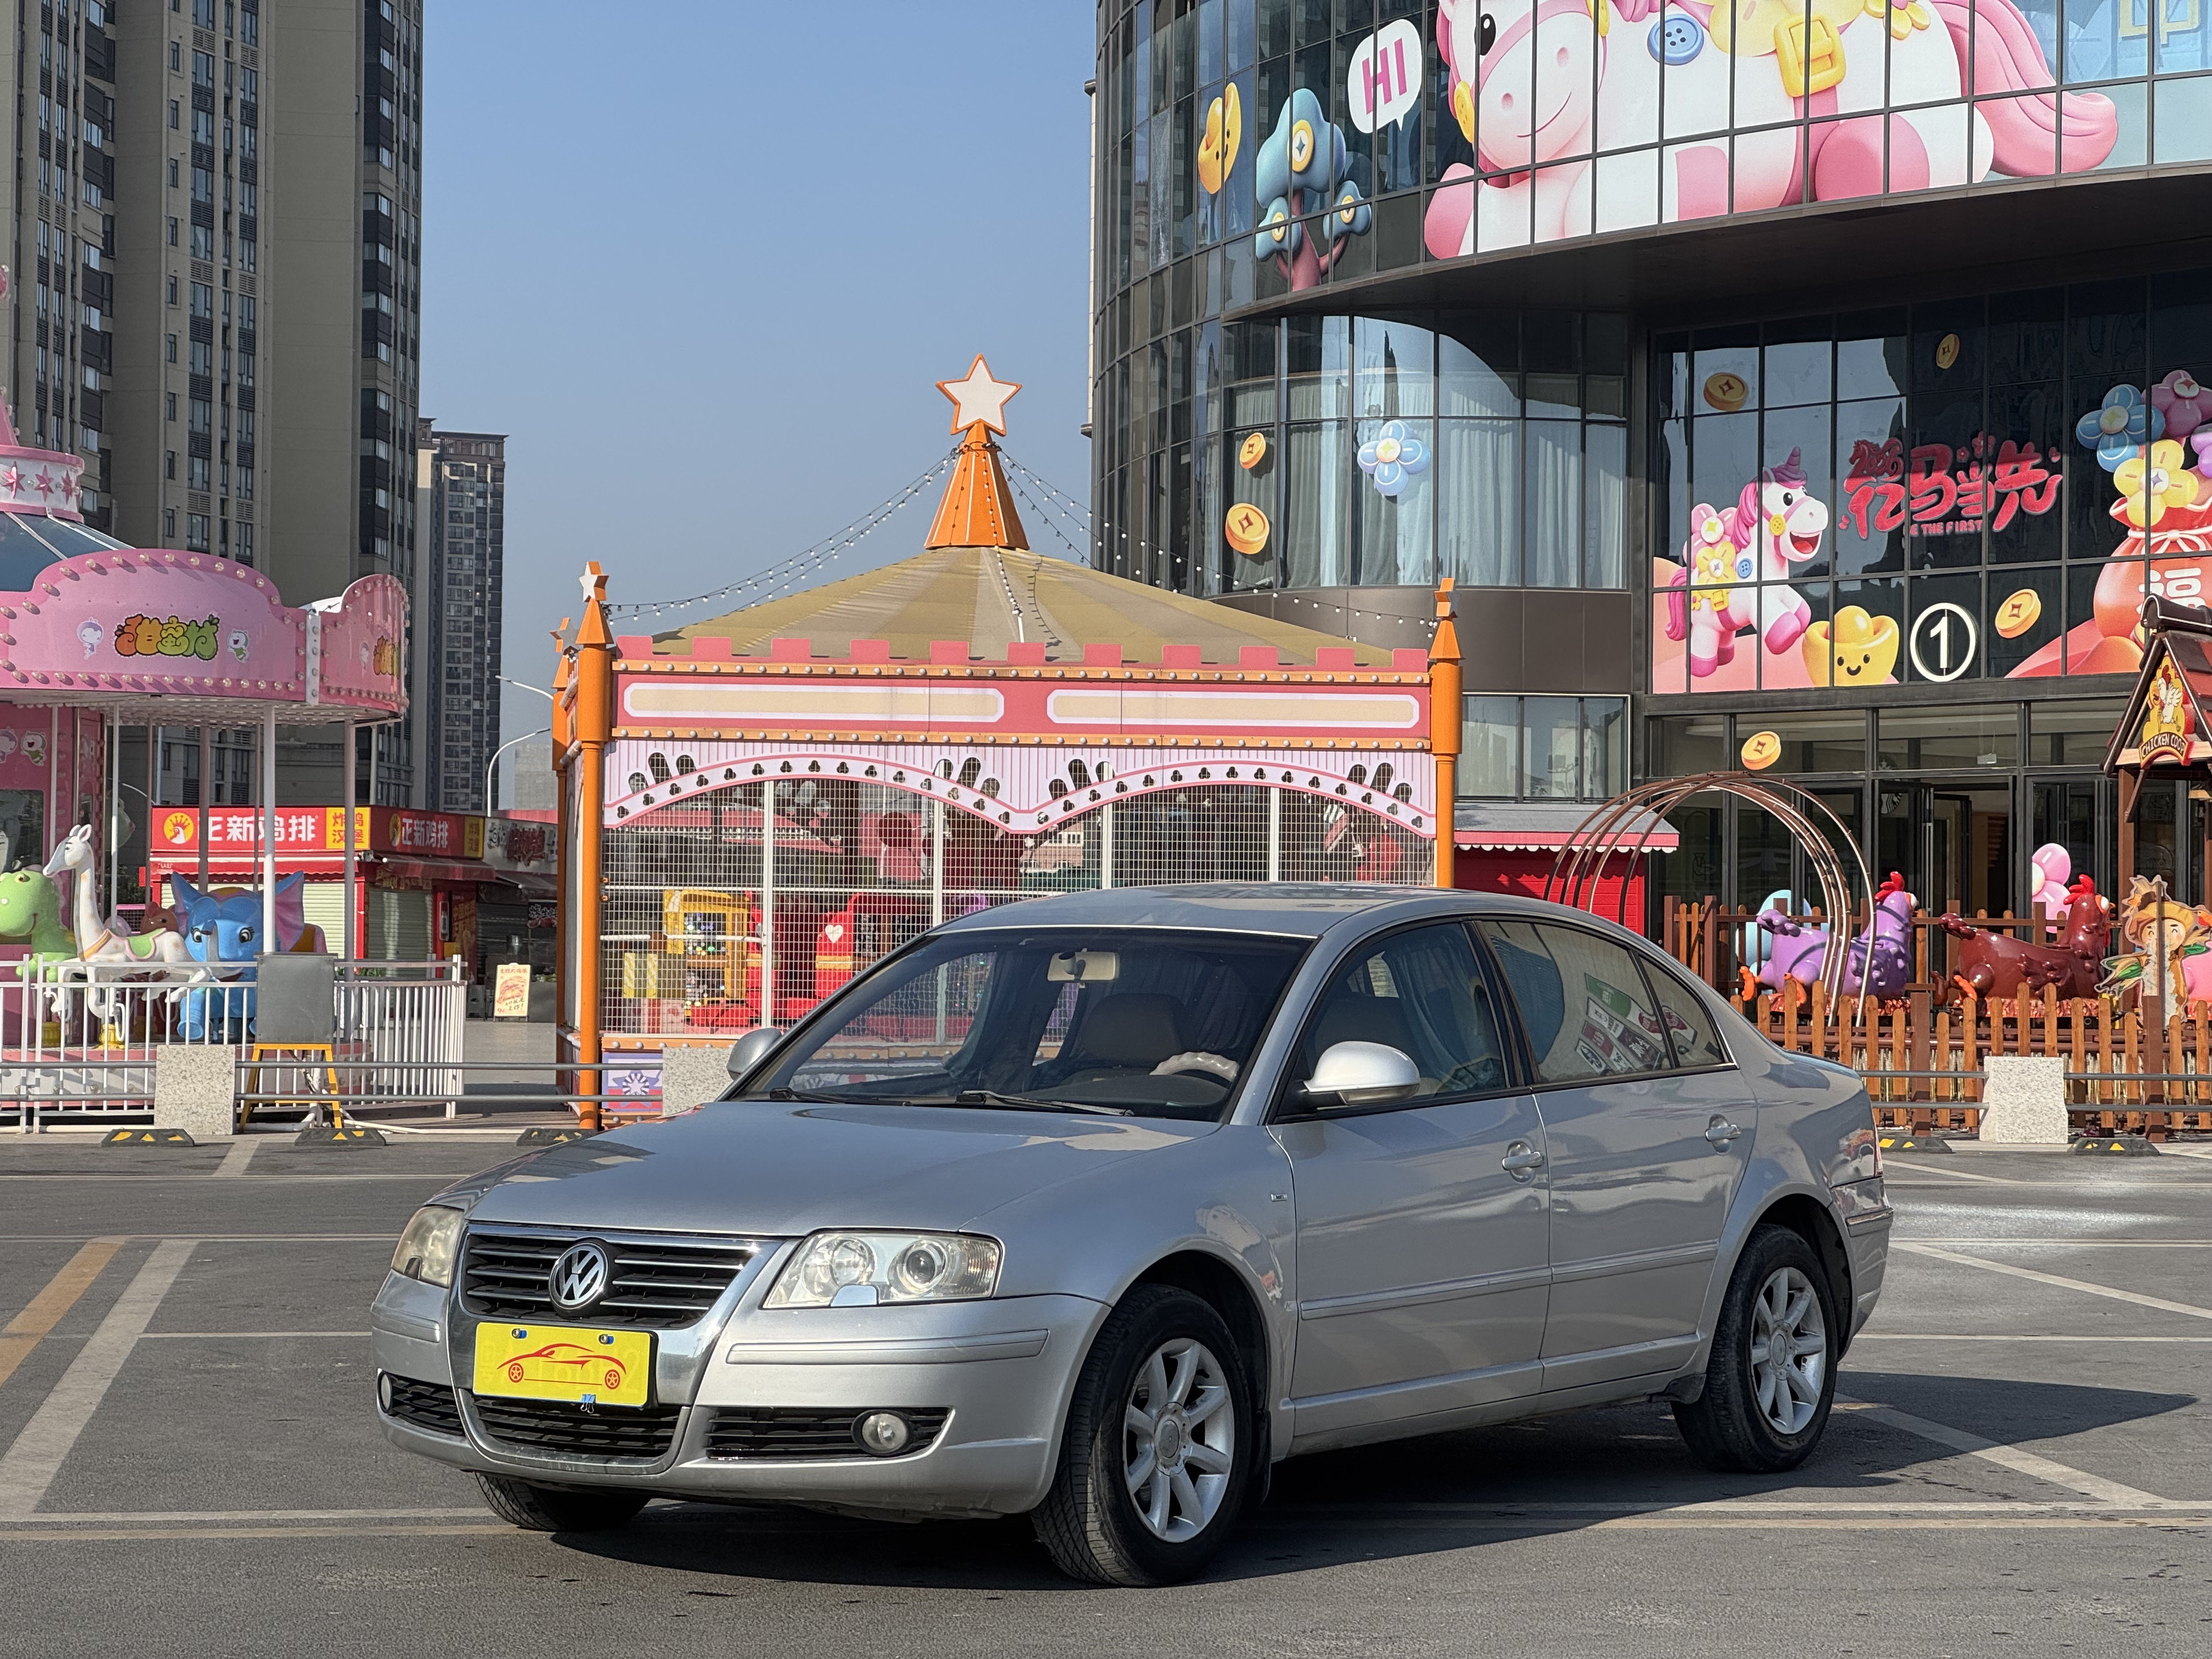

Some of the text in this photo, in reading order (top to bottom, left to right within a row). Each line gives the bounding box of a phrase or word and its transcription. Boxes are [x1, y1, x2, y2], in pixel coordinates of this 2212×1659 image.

[1362, 37, 1407, 115] HI
[1921, 522, 1944, 534] THE
[1945, 520, 1983, 534] FIRST
[2142, 733, 2185, 757] CHICKEN COOP
[198, 815, 315, 842] 正新鸡排
[332, 812, 363, 827] 炸鸡
[332, 830, 363, 843] 汉堡
[402, 818, 448, 849] 正新鸡排
